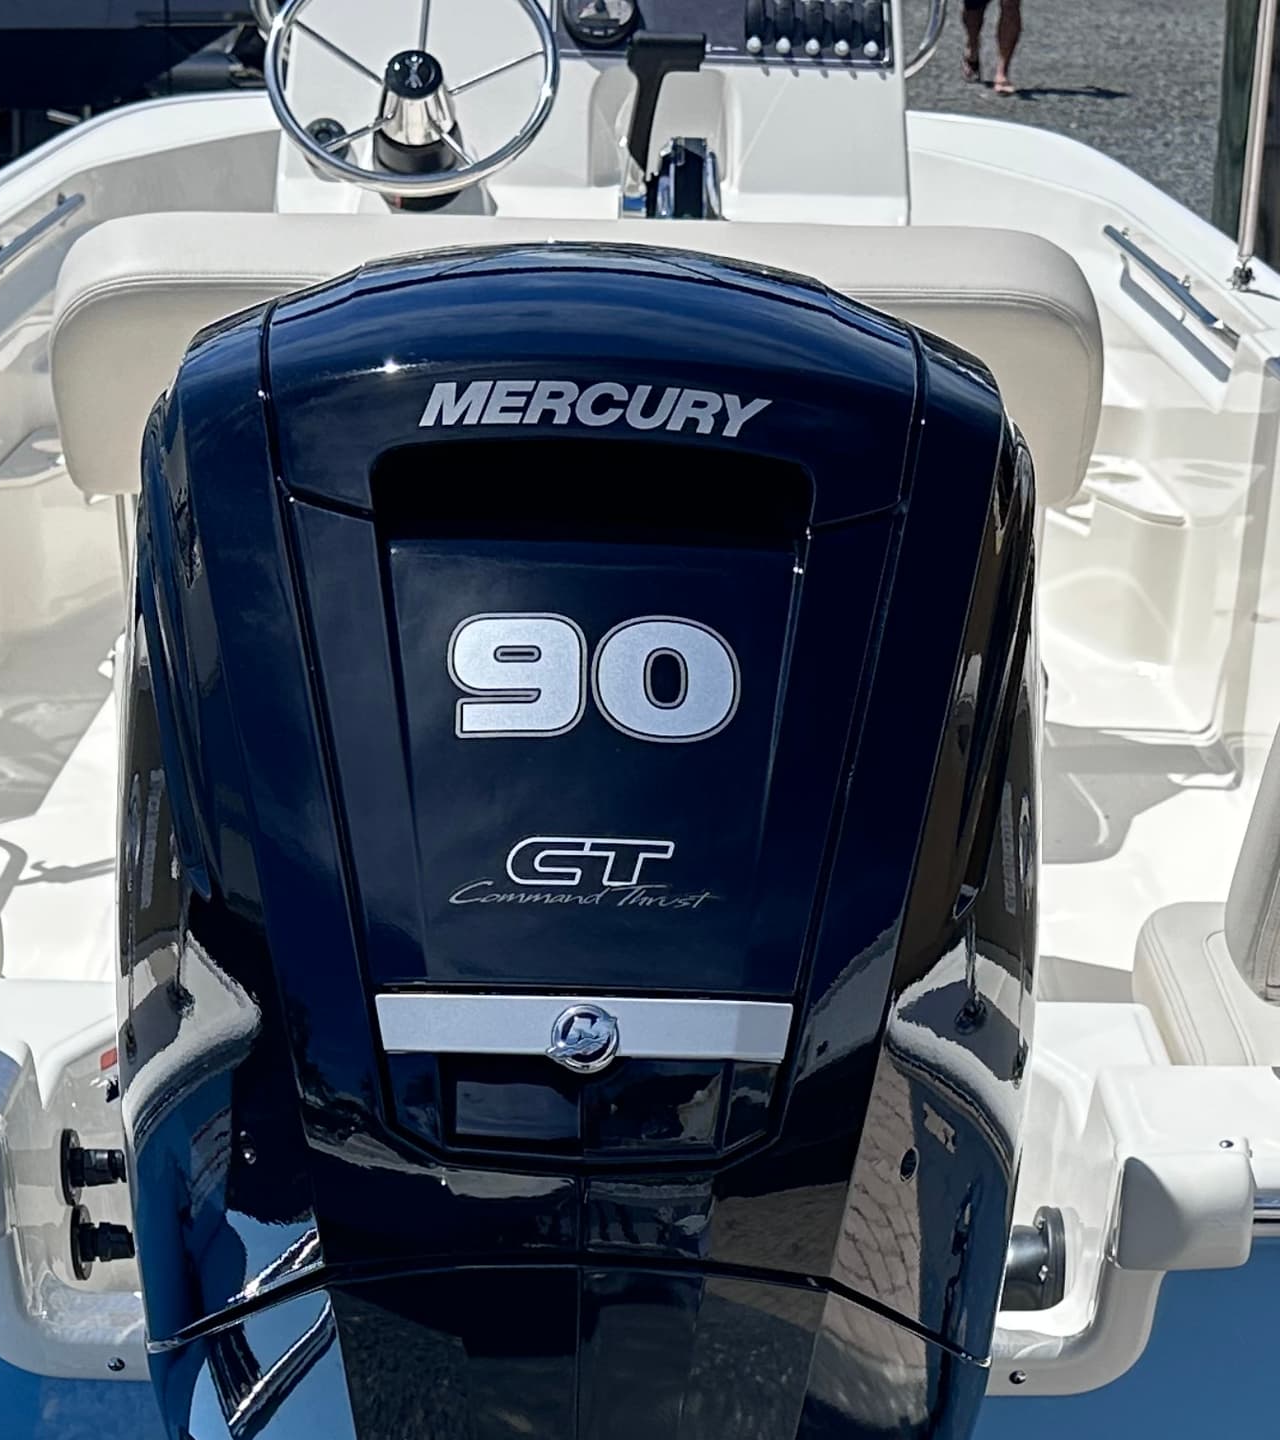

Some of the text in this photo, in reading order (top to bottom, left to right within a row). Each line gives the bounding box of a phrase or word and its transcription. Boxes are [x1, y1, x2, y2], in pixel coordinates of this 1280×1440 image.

[418, 379, 773, 438] MERCURY
[447, 611, 741, 744] 90
[506, 835, 675, 886] GT
[449, 879, 715, 908] Command Thrust
